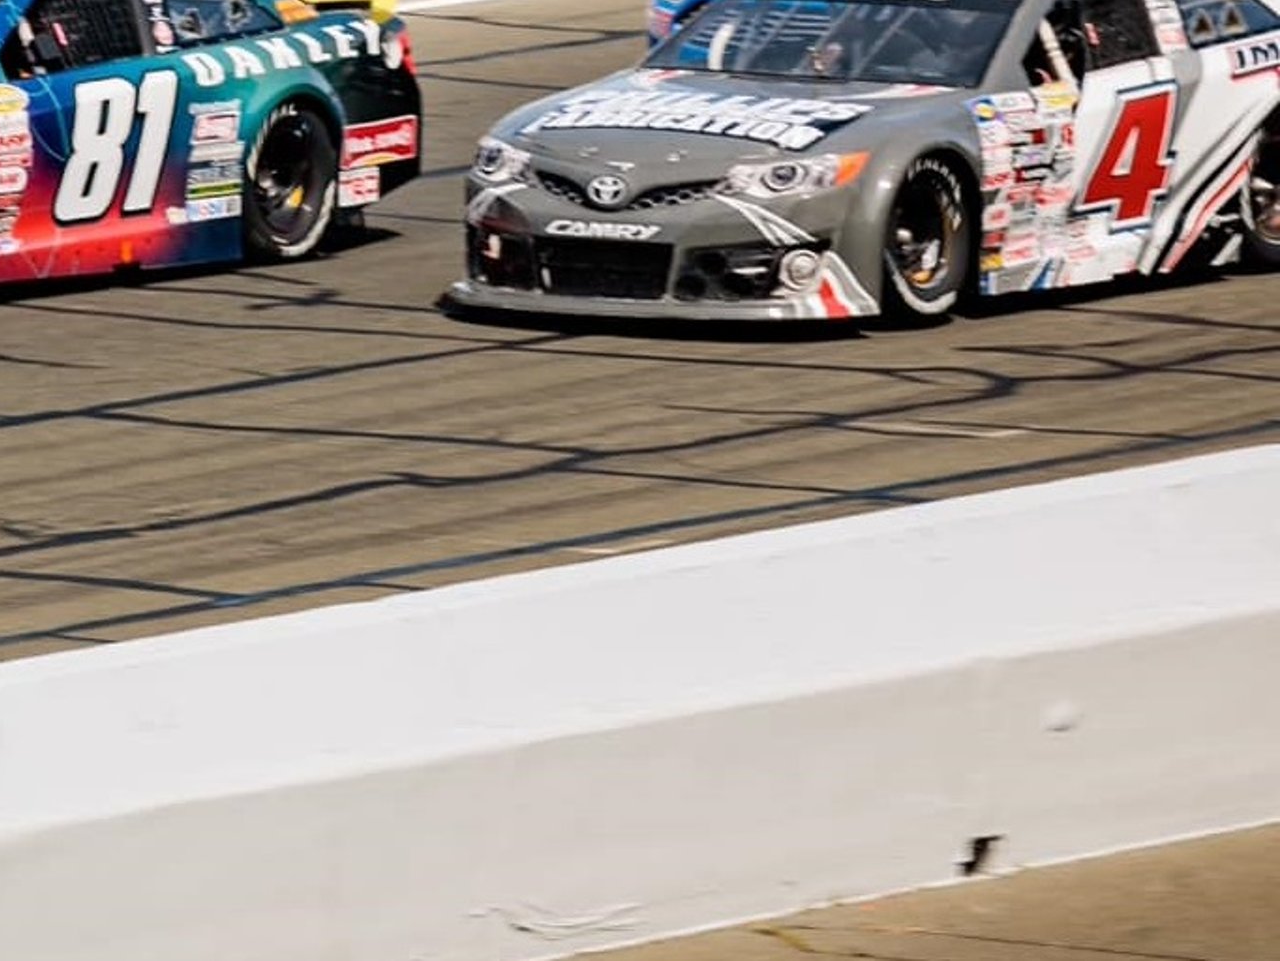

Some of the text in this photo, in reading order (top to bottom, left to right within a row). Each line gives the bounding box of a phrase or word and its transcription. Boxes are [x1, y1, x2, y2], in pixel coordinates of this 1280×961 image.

[53, 70, 178, 227] 81
[1076, 85, 1176, 229] 4
[544, 219, 663, 239] CAMRY
